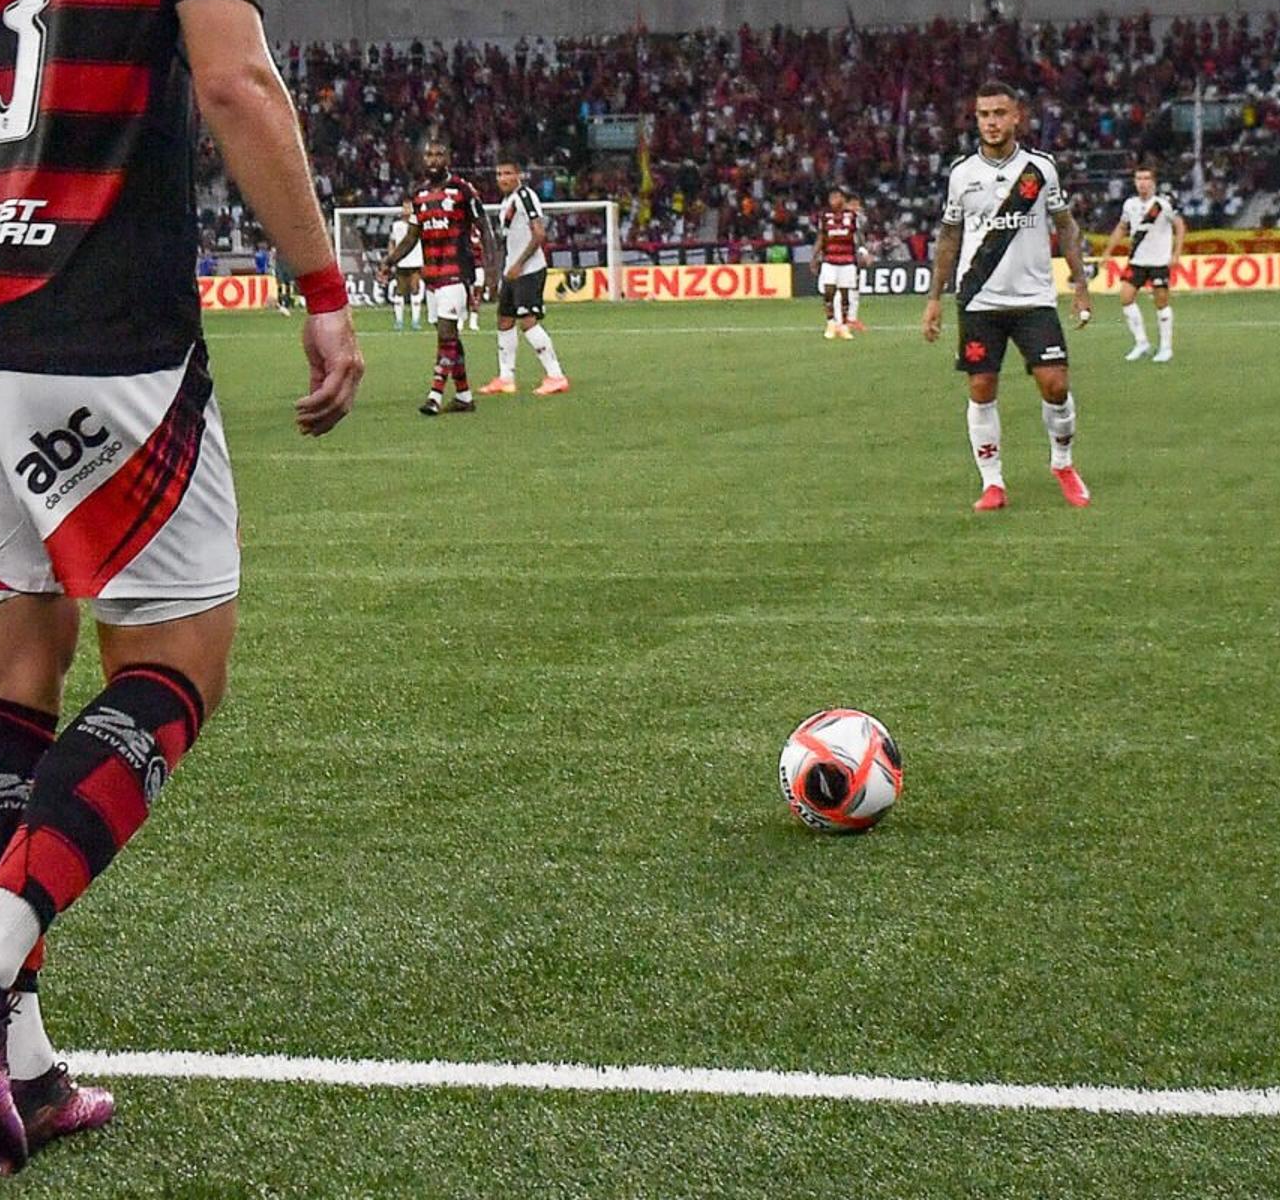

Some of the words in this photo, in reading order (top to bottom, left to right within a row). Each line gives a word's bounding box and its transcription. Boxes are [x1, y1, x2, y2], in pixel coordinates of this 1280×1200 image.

[983, 211, 1039, 231] betfair
[859, 267, 907, 294] LEO
[15, 406, 110, 494] abc
[46, 493, 61, 510] da
[60, 441, 122, 494] construção
[77, 723, 142, 769] DELIVERY
